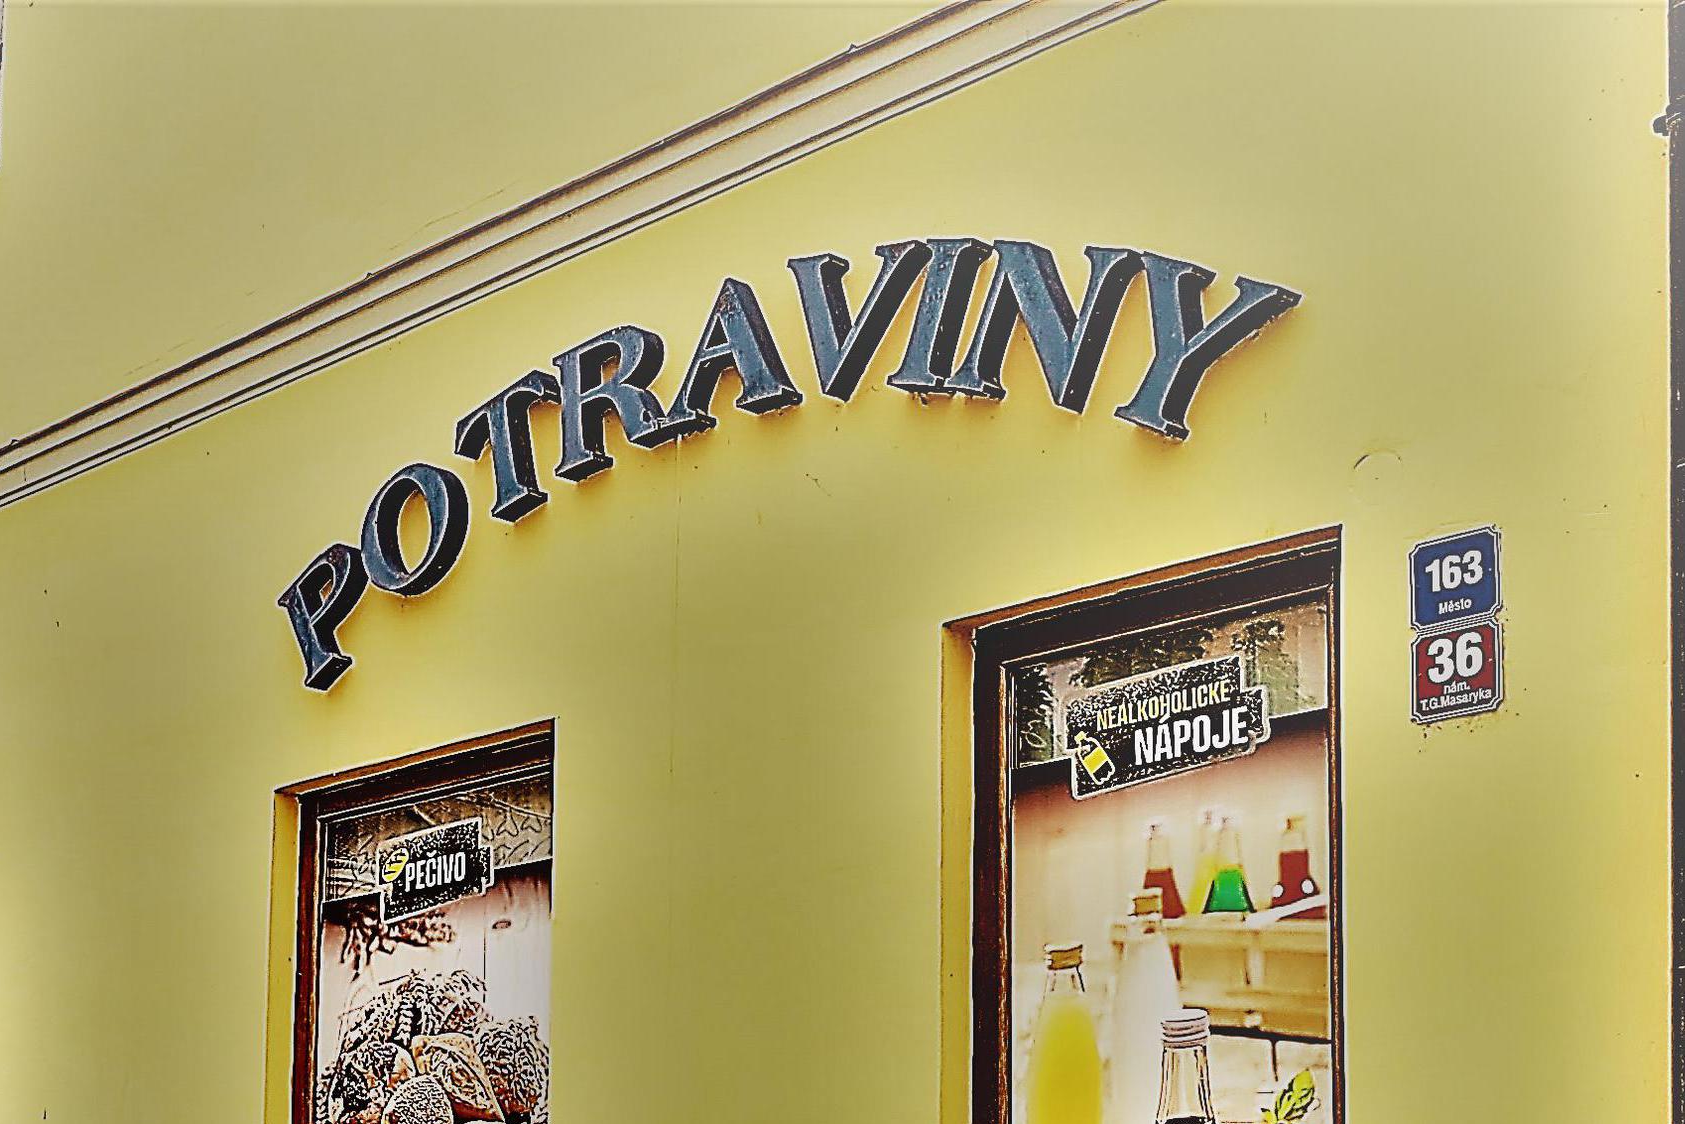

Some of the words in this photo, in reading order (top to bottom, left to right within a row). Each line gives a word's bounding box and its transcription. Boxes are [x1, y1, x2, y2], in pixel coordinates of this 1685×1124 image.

[275, 237, 1303, 693] POTRAVINY
[1425, 549, 1484, 592] 163
[1438, 597, 1472, 615] Město
[1427, 631, 1483, 684] 36
[1443, 679, 1471, 695] nám.
[1134, 705, 1249, 766] NÁPOJE
[404, 848, 466, 892] PEČIVO
